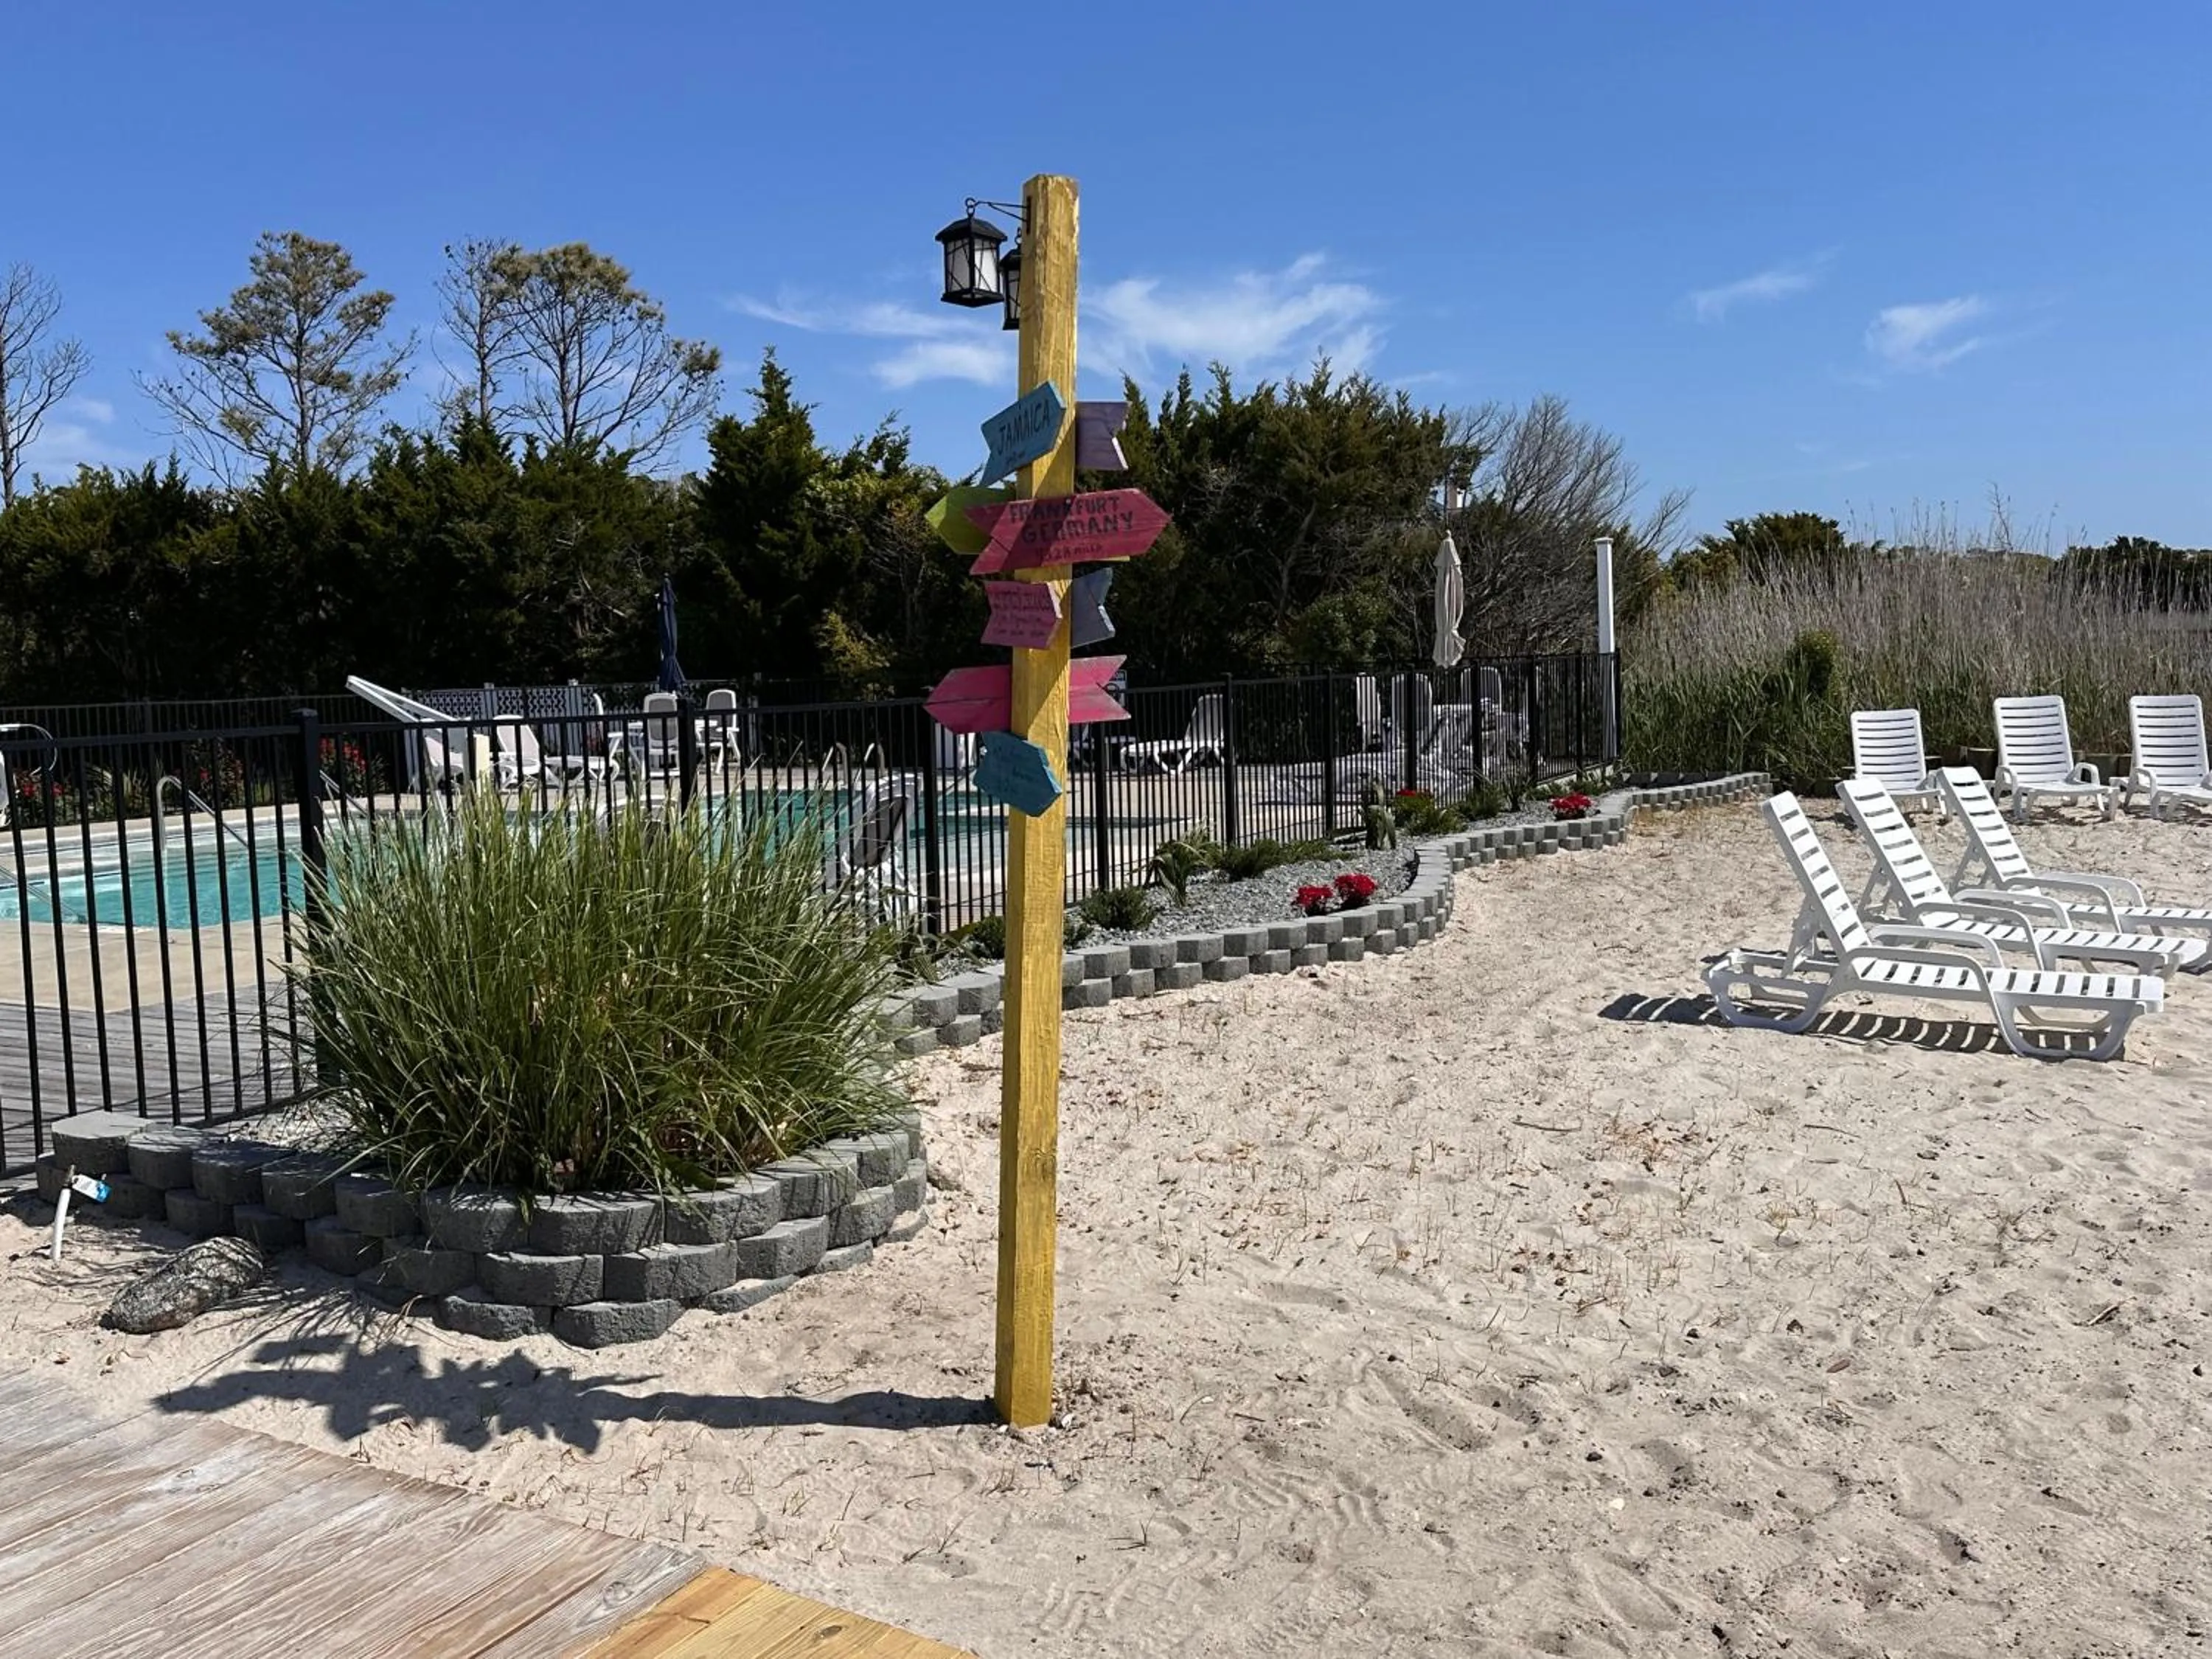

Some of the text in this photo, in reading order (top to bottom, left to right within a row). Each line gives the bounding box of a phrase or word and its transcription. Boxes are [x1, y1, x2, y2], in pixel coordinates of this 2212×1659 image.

[997, 399, 1051, 456] JAMAICA
[1009, 496, 1120, 524] FRANKFURT
[1022, 511, 1133, 543] GERMANY
